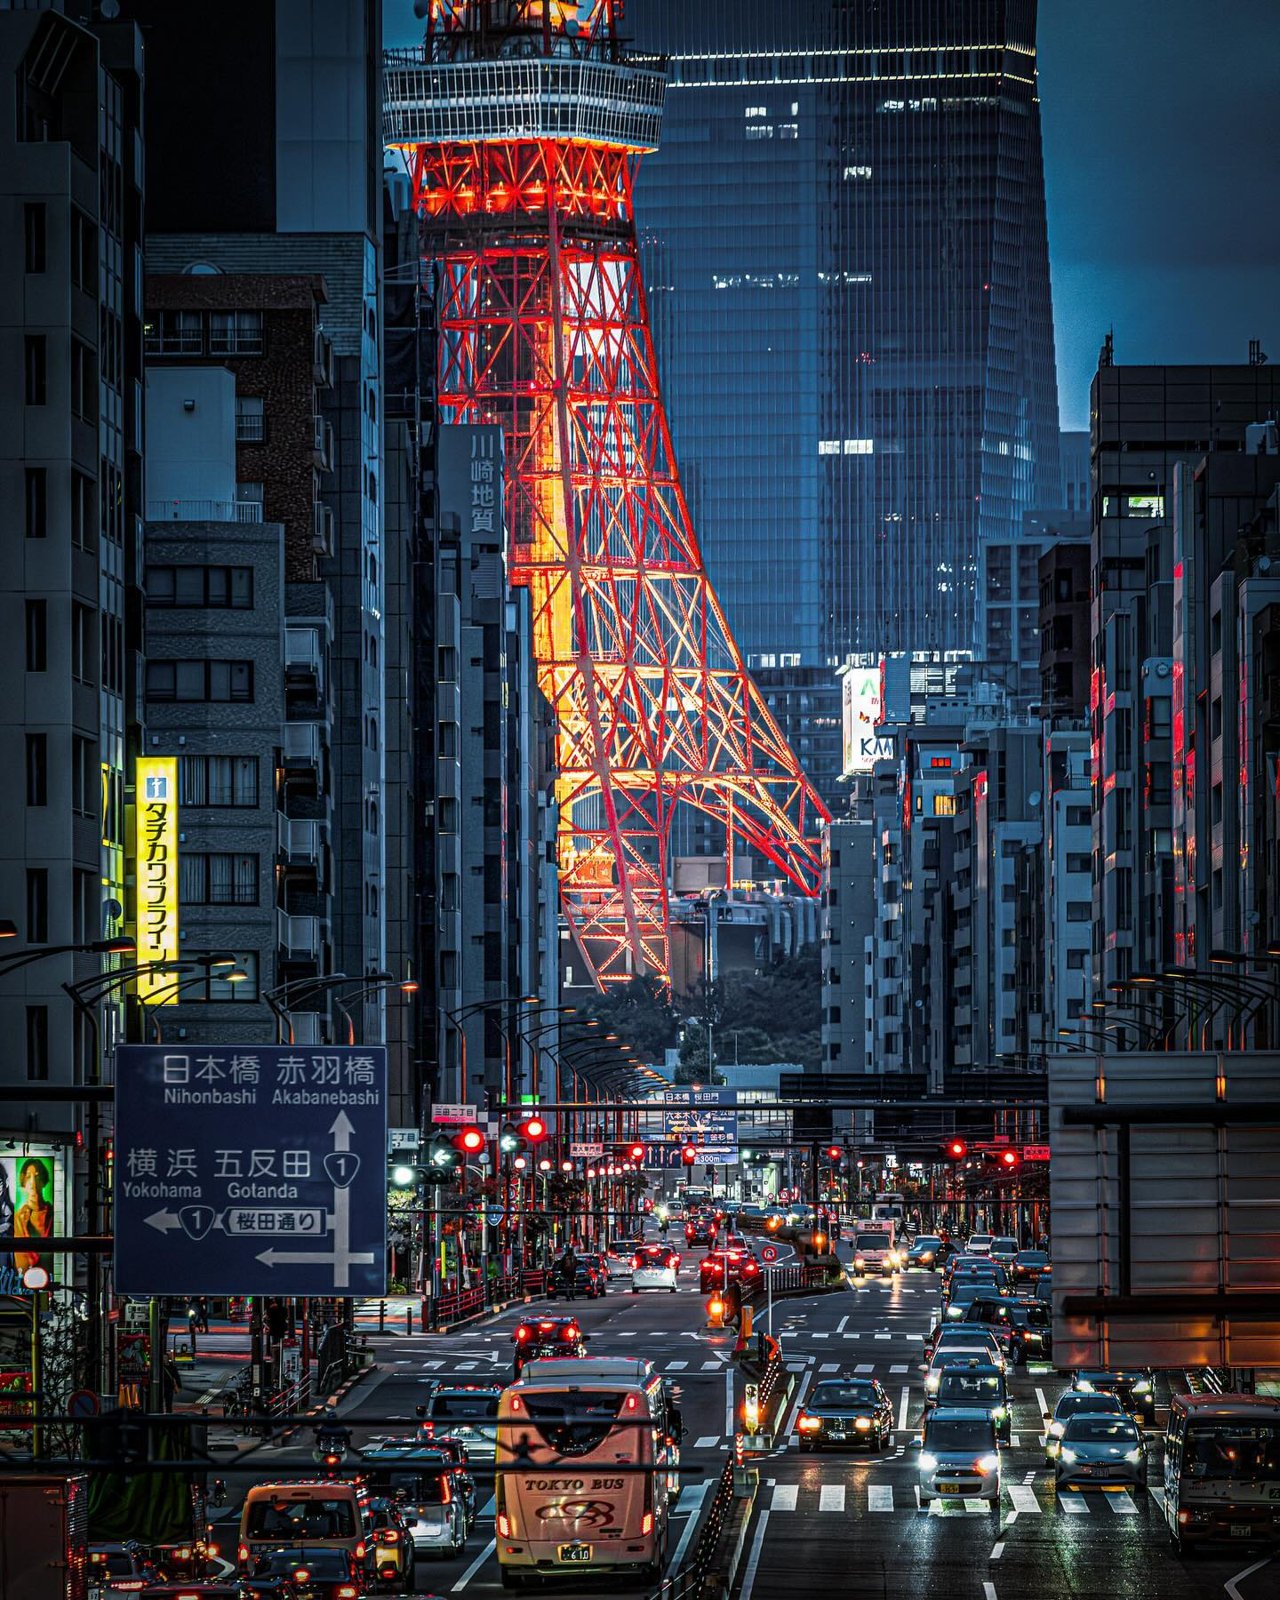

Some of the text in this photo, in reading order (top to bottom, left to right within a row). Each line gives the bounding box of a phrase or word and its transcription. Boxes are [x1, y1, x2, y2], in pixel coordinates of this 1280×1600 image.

[471, 434, 494, 533] 川崎地質
[163, 1055, 375, 1085] 日本橋 赤羽橋
[164, 1088, 379, 1106] Nihonbashi Akabanebashi
[126, 1148, 311, 1178] 横浜 五反田
[336, 1158, 346, 1177] 1
[123, 1182, 298, 1199] Yokohama Gotanda
[191, 1211, 201, 1229] 1
[236, 1212, 315, 1232] 桜田通り
[525, 1478, 625, 1491] TOKYO BUS
